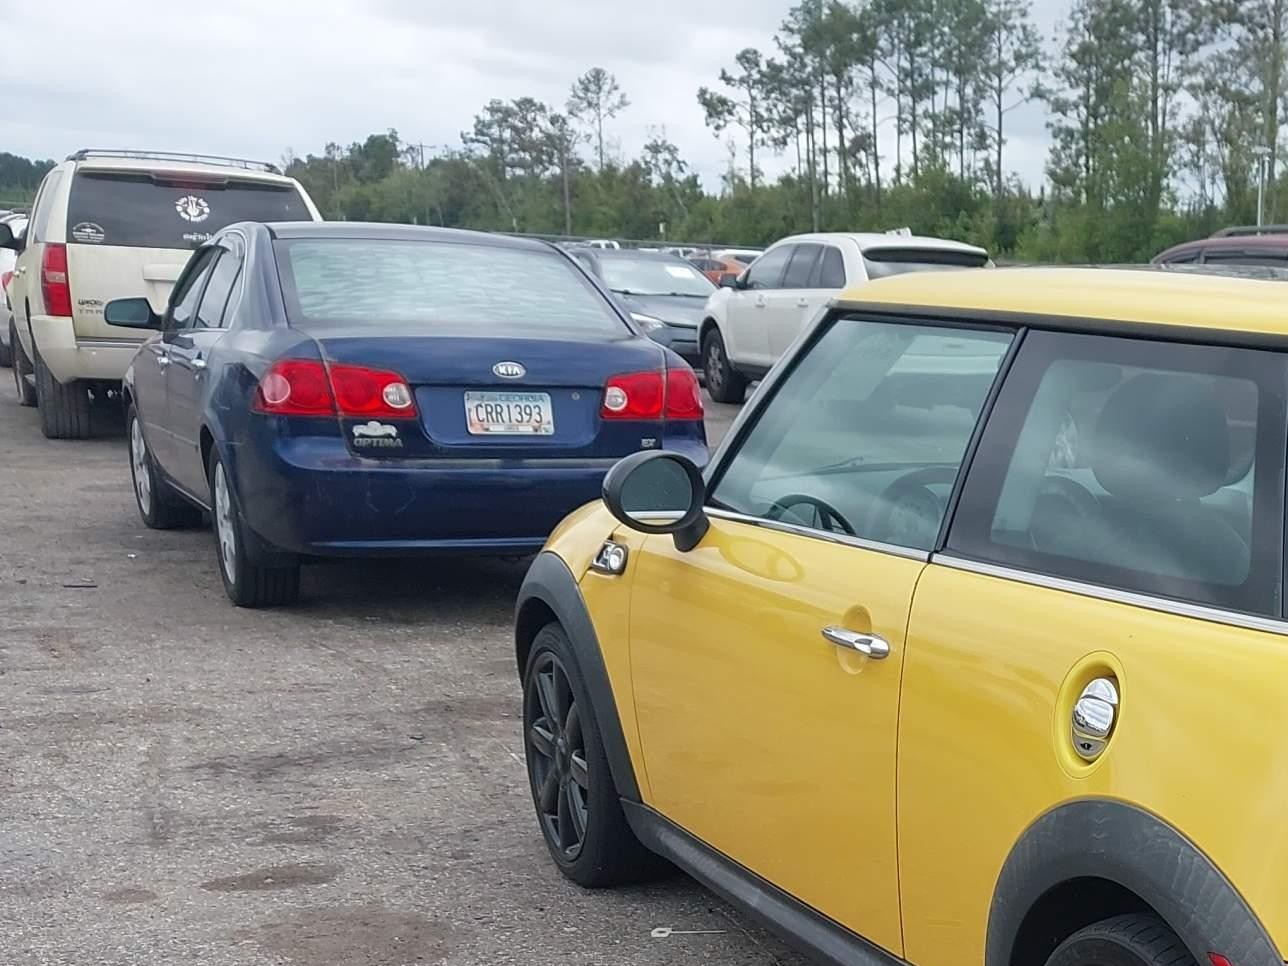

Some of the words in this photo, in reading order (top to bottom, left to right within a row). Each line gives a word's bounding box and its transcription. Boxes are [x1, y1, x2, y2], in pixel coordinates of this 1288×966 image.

[497, 364, 522, 377] KIA
[474, 402, 544, 424] CRR1393
[353, 437, 404, 448] OPTIMA
